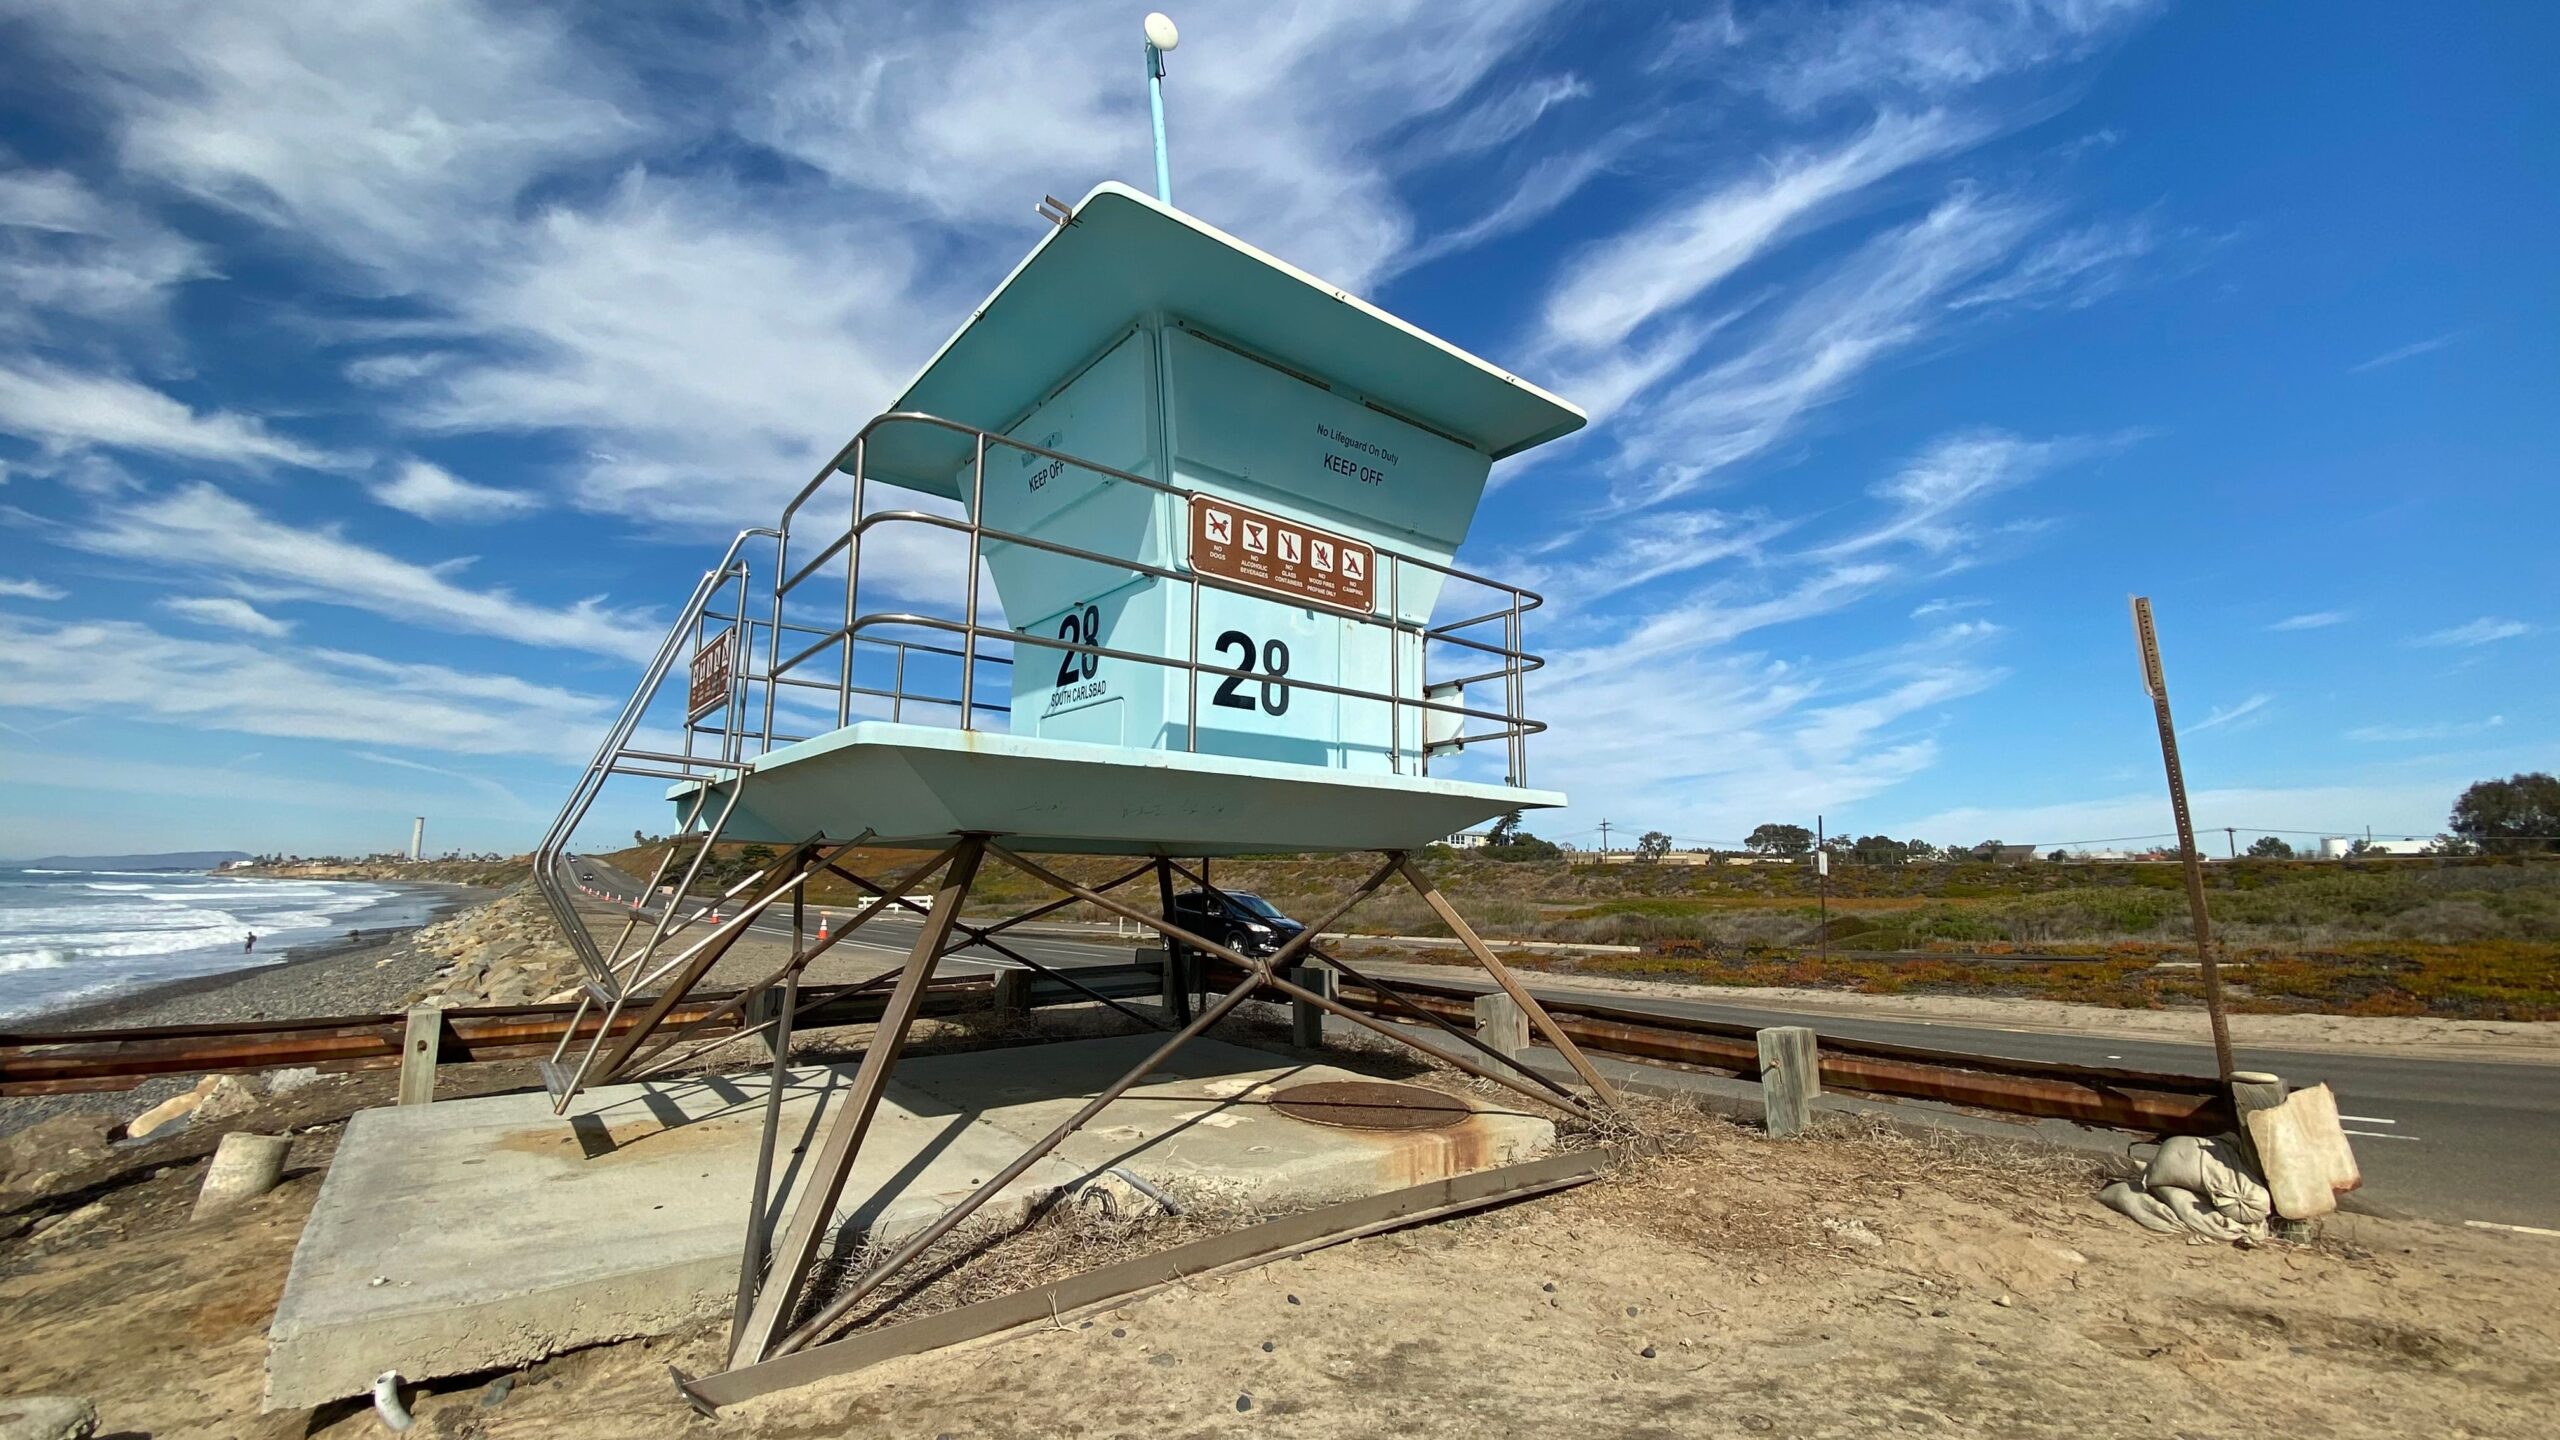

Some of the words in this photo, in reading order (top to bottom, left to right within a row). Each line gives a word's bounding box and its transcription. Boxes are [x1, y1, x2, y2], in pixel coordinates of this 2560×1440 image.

[1316, 423, 1329, 437] No
[1330, 428, 1368, 452] Lifeguard
[1368, 444, 1380, 457] On
[1381, 448, 1399, 466] Duty
[1323, 452, 1357, 477] KEEP
[1360, 466, 1384, 486] OFF
[1028, 468, 1048, 494] KEEP
[1049, 460, 1065, 479] OFF
[1213, 544, 1223, 552] NO
[1209, 551, 1226, 561] DOGS
[1250, 554, 1259, 562] NO
[1240, 559, 1268, 572] ALCOHOLIC
[1285, 563, 1294, 571] NO
[1240, 566, 1269, 579] BEVERAGES
[1281, 570, 1297, 579] GLASS
[1274, 576, 1303, 588] CONTAINERS
[1342, 585, 1364, 596] CAMPING
[1056, 604, 1100, 688] 28
[1212, 630, 1290, 717] 28
[1050, 688, 1072, 707] SOUTH
[1072, 680, 1107, 702] CARLSBAD
